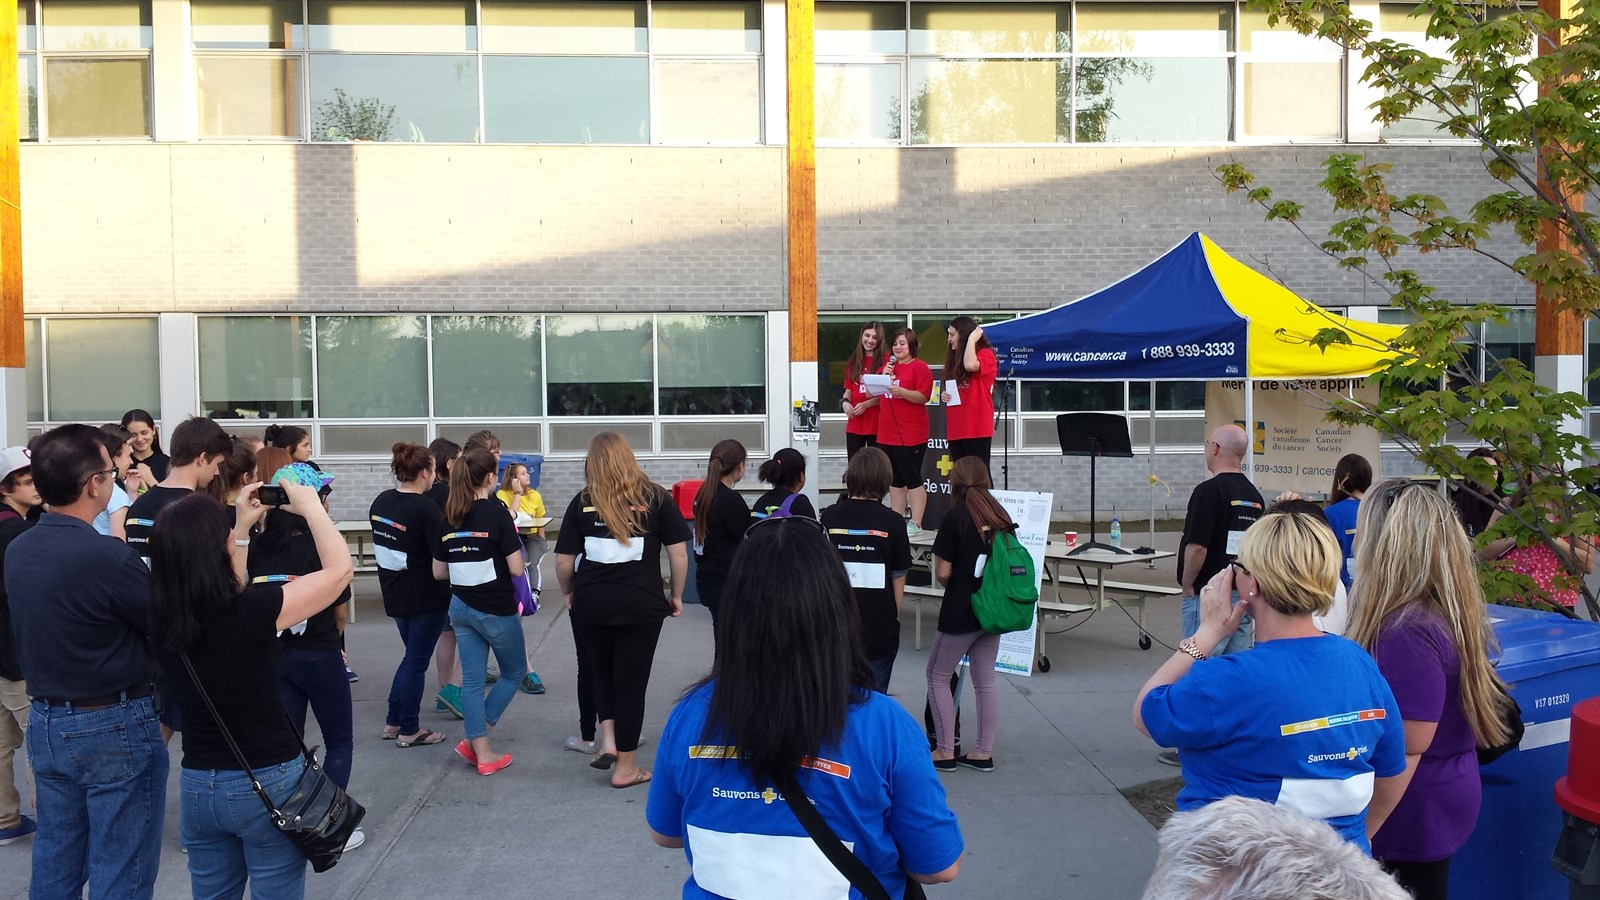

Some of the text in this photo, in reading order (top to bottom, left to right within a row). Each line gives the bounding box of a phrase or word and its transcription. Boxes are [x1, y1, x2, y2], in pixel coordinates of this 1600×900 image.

[1150, 345, 1175, 359] 888
[1176, 341, 1235, 358] 939-3333
[1045, 351, 1128, 362] www.cancer.ca
[1315, 427, 1352, 436] Canadian
[1316, 445, 1344, 454] Society
[1254, 463, 1294, 475] 939-3333
[1301, 466, 1337, 476] cancer
[1547, 693, 1570, 707] 012329
[1307, 753, 1346, 764] Sauvons
[712, 786, 761, 800] Sauvons
